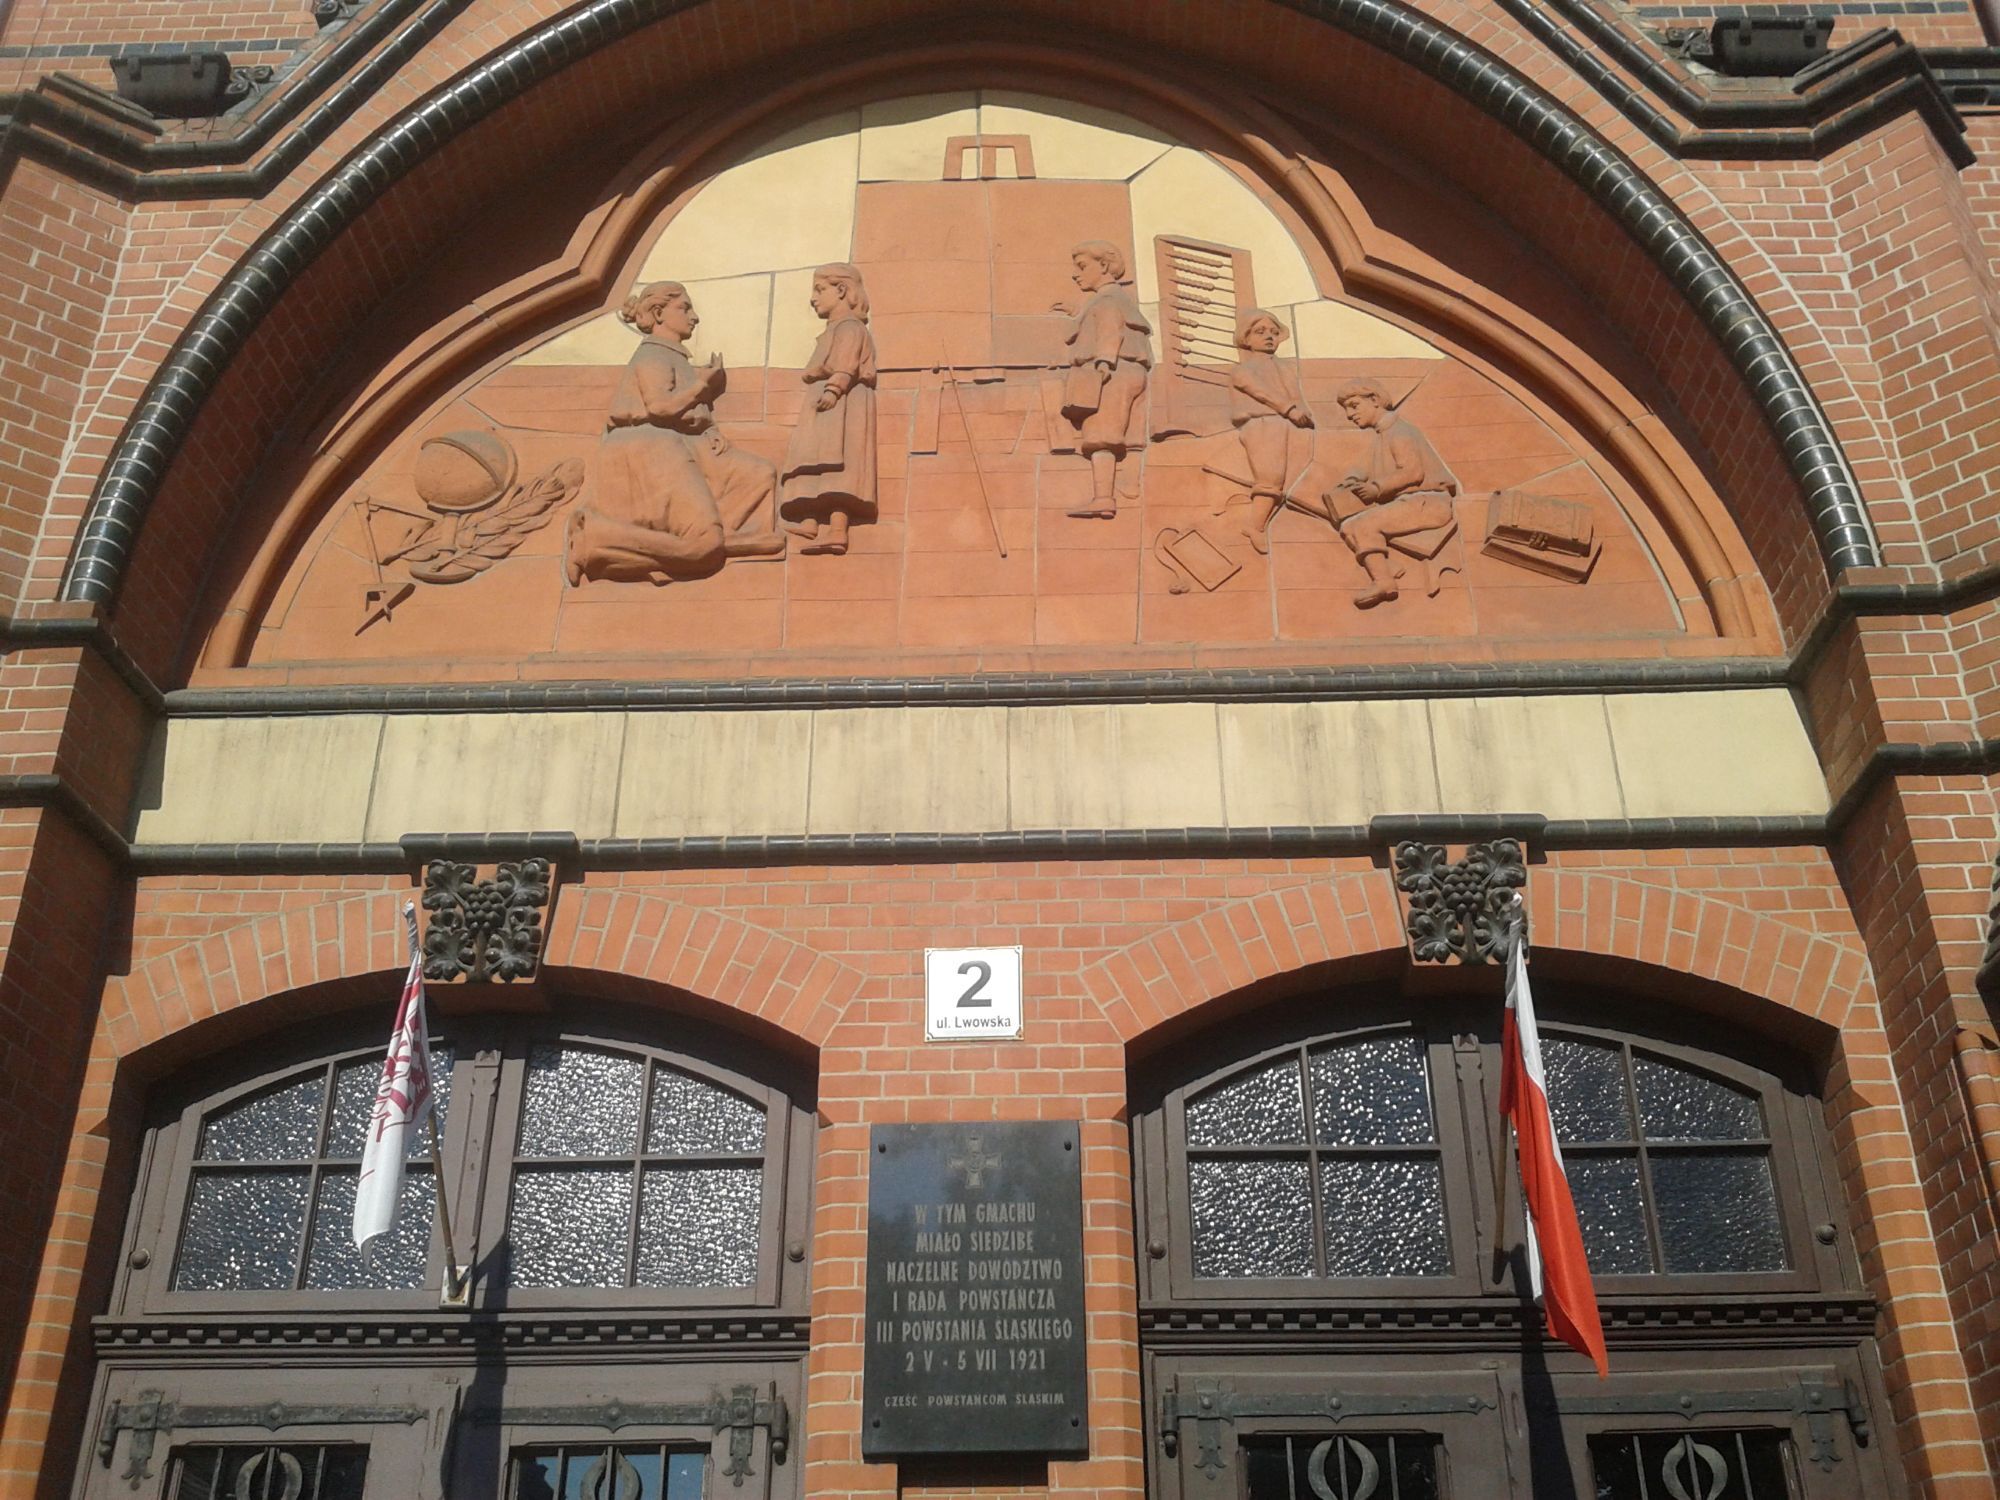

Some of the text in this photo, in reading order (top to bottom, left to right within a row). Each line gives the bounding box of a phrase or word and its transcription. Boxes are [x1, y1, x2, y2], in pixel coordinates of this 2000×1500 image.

[956, 960, 992, 1008] 2
[936, 1015, 1011, 1029] ul. Lwowska
[914, 1202, 1036, 1224] W TYM GMACHU
[916, 1231, 961, 1253] MIAŁO
[886, 1258, 1063, 1282] NACZELNE DOWÓDZTWO
[893, 1286, 1056, 1312] I RADA POWSTAŃCZA
[876, 1316, 1073, 1343] III POWSTANIA ŚLĄSKIEGO
[905, 1351, 914, 1372] 2
[923, 1350, 933, 1372] V
[975, 1349, 997, 1371] VII
[1009, 1349, 1046, 1370] 1921
